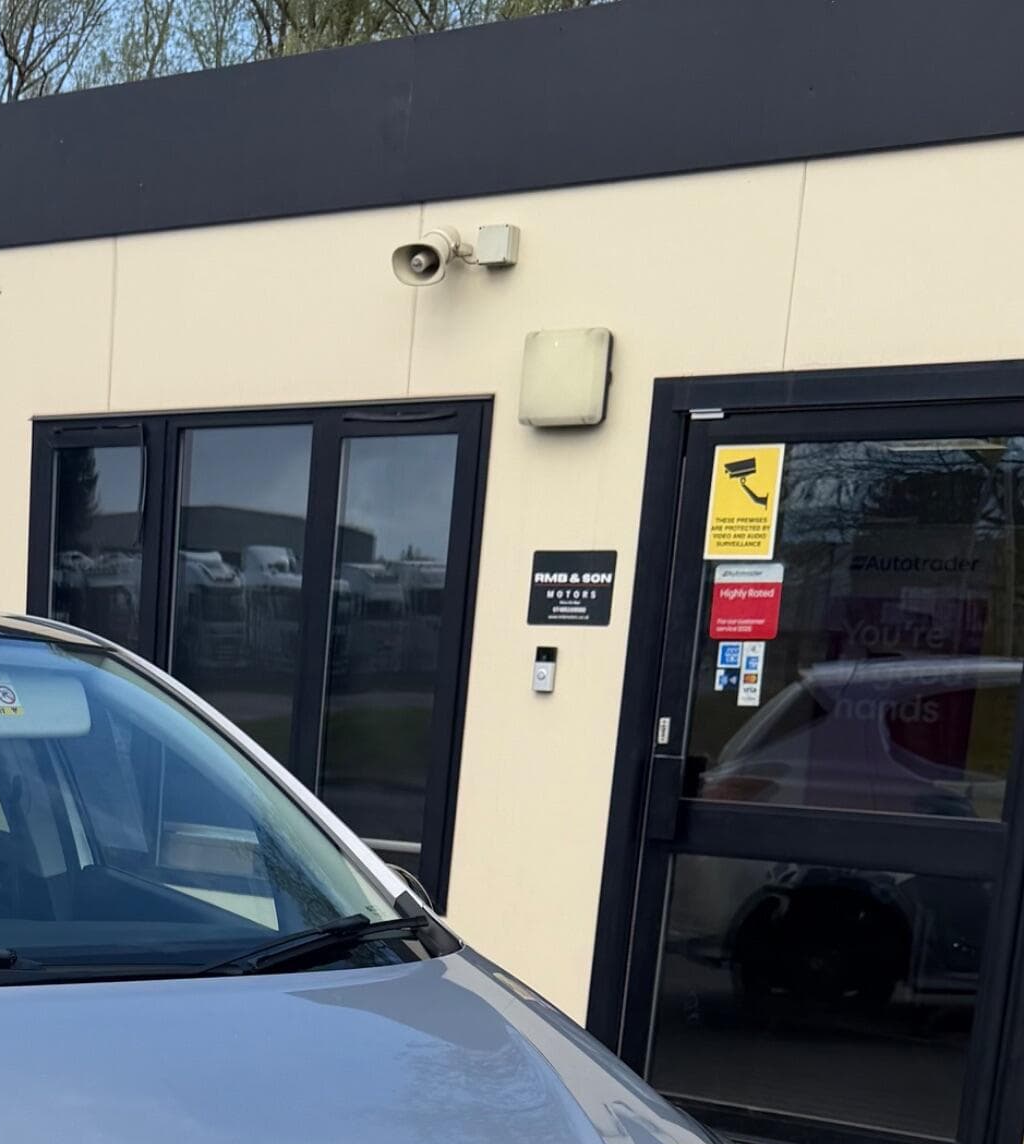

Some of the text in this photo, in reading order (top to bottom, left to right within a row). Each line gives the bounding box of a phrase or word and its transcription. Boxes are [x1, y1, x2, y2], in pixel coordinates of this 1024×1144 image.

[865, 555, 980, 572] Autotrader
[534, 573, 612, 583] RMB & SON
[546, 590, 597, 599] MOTORS
[719, 588, 775, 600] Highly Rated
